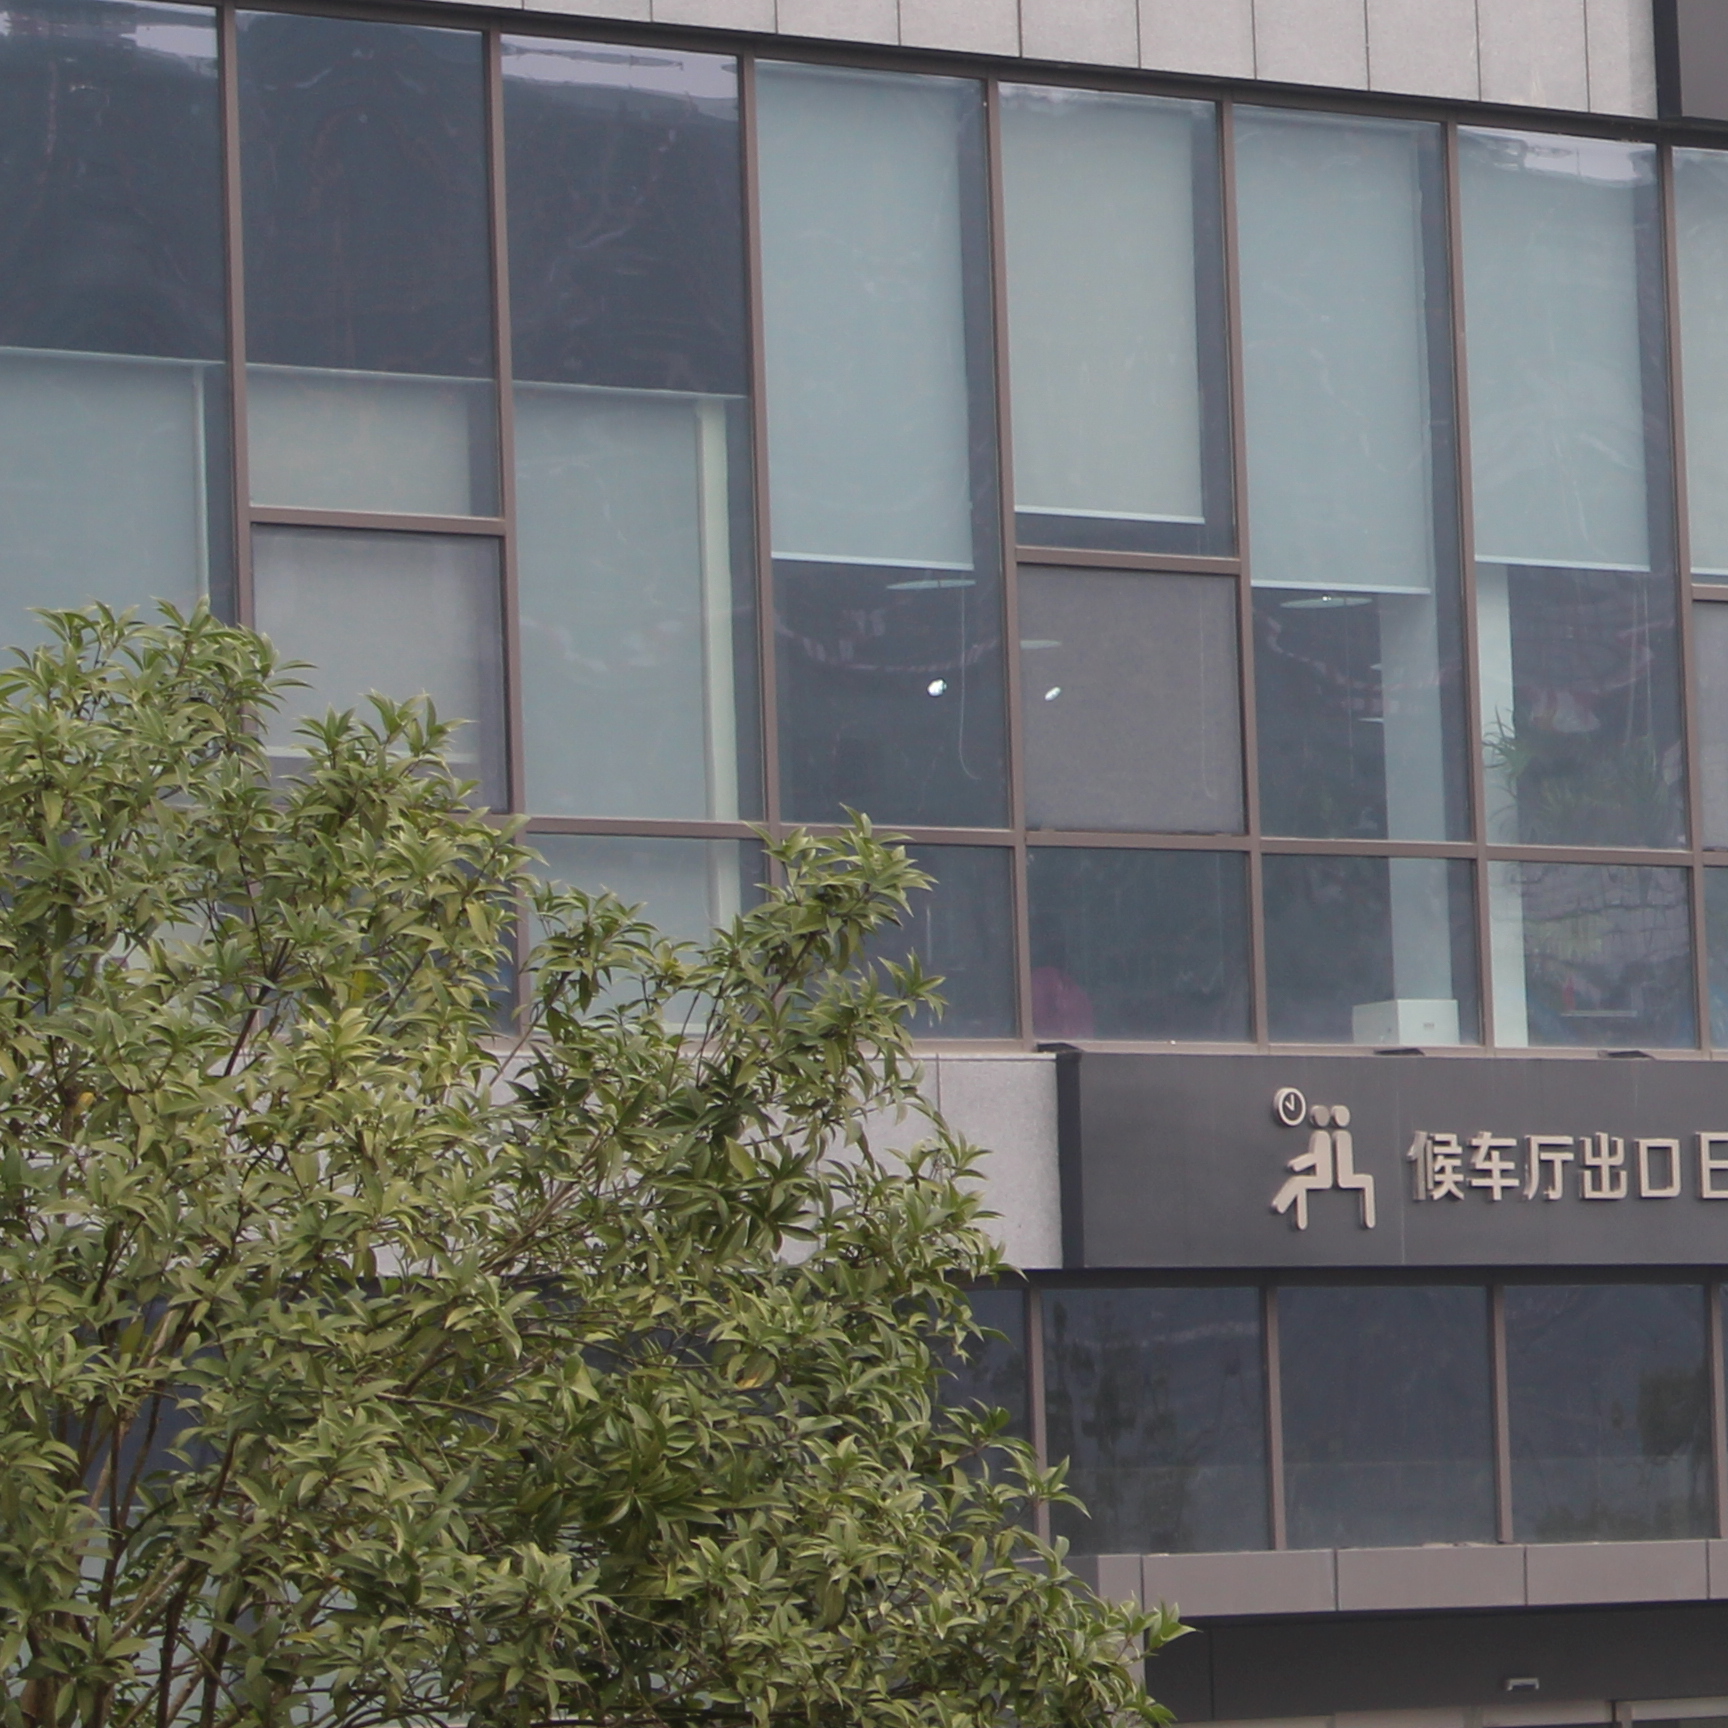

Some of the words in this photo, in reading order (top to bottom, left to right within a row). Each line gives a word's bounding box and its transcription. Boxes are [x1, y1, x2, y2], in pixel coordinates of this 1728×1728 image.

[1407, 1129, 1683, 1201] 候车厅出口
